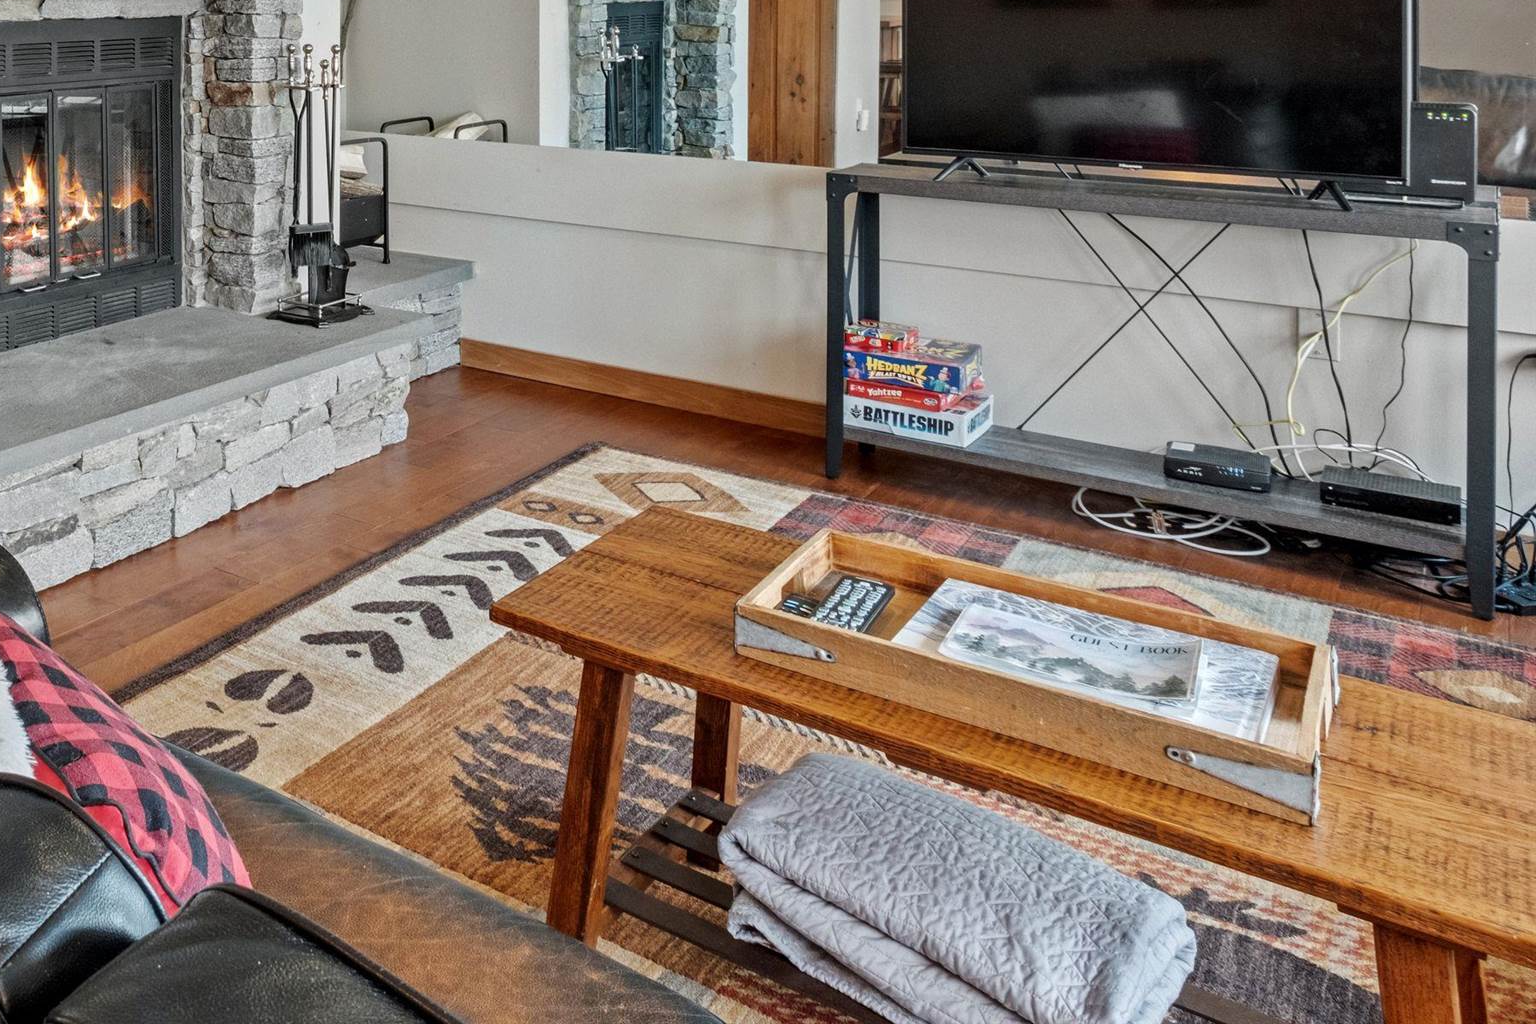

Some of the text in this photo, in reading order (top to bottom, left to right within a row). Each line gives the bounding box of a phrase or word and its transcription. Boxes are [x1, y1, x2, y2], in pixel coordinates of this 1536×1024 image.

[866, 388, 903, 397] Yahtzee
[863, 405, 954, 436] BATTLESHIP
[1140, 645, 1188, 655] BOOK
